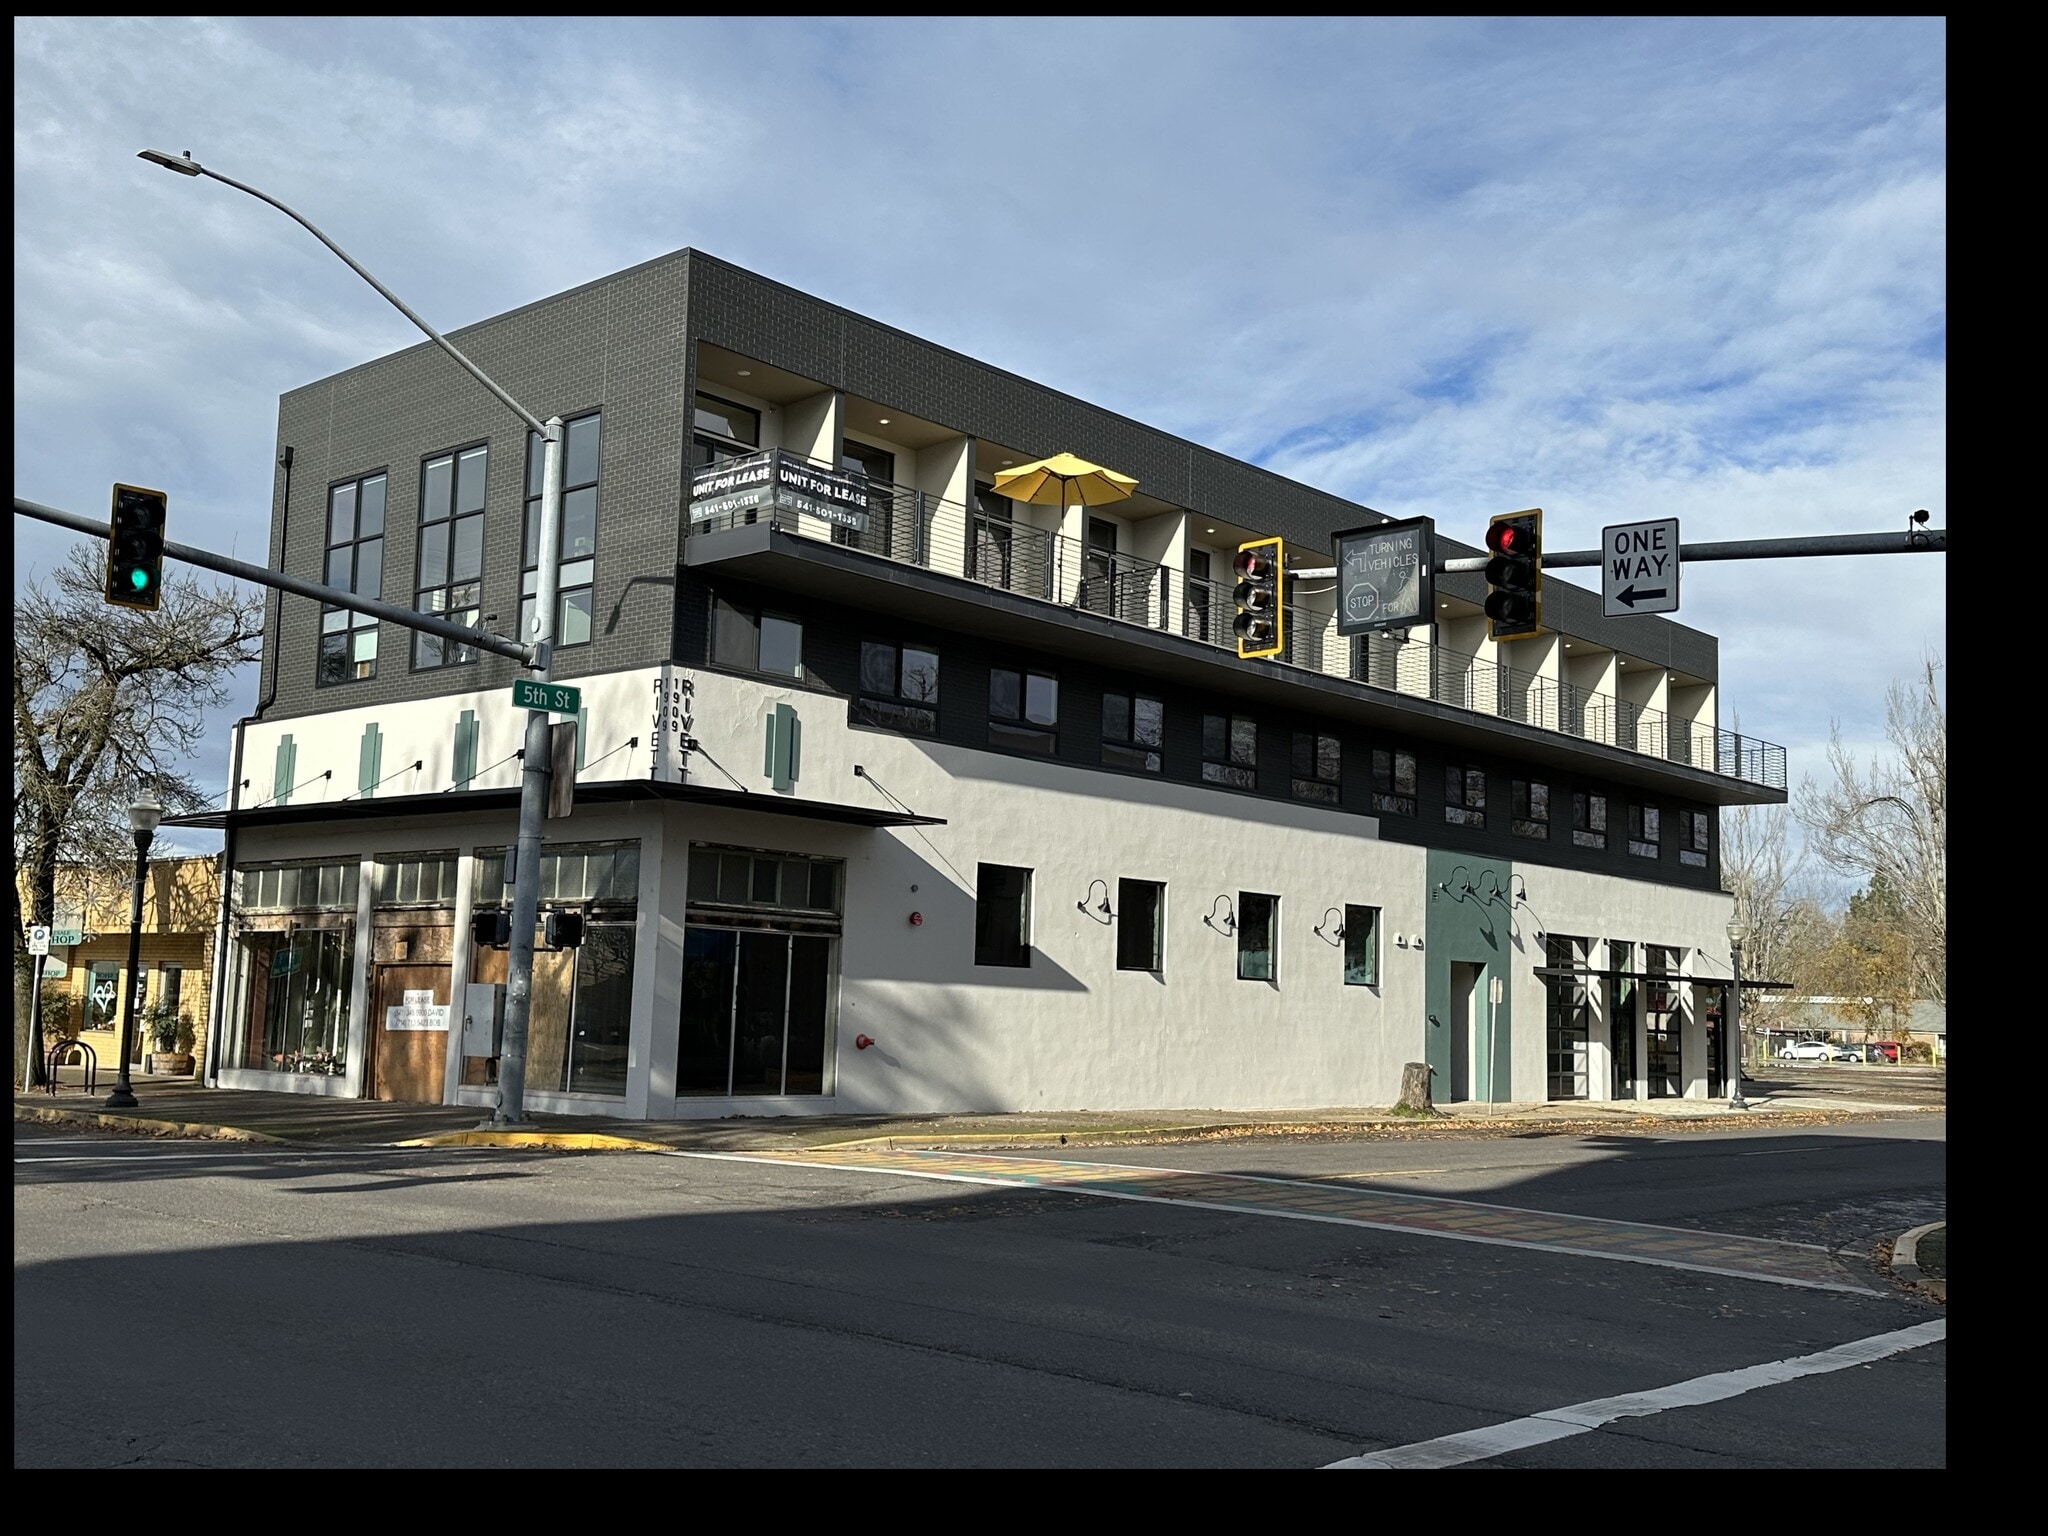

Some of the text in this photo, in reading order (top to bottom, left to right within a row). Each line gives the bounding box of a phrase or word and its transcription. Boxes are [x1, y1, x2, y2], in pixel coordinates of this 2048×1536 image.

[693, 481, 714, 496] UNIT
[715, 476, 734, 490] FOR
[736, 467, 770, 485] LEASE
[780, 469, 808, 487] UNIT
[810, 479, 832, 496] FOR
[835, 487, 867, 507] LEASE
[1369, 537, 1412, 555] TURNING
[1614, 527, 1667, 555] ONE
[1368, 553, 1418, 571] VEHICLES
[1613, 554, 1669, 581] WAY
[1350, 594, 1374, 609] STOP
[1382, 602, 1399, 613] FOR
[523, 686, 570, 709] 5th St
[671, 677, 680, 732] 1909
[650, 678, 663, 780] RIVETT
[679, 679, 693, 783] RIVETT
[51, 935, 75, 944] HOP
[415, 996, 430, 1004] LEASE
[428, 1008, 444, 1017] DAVID
